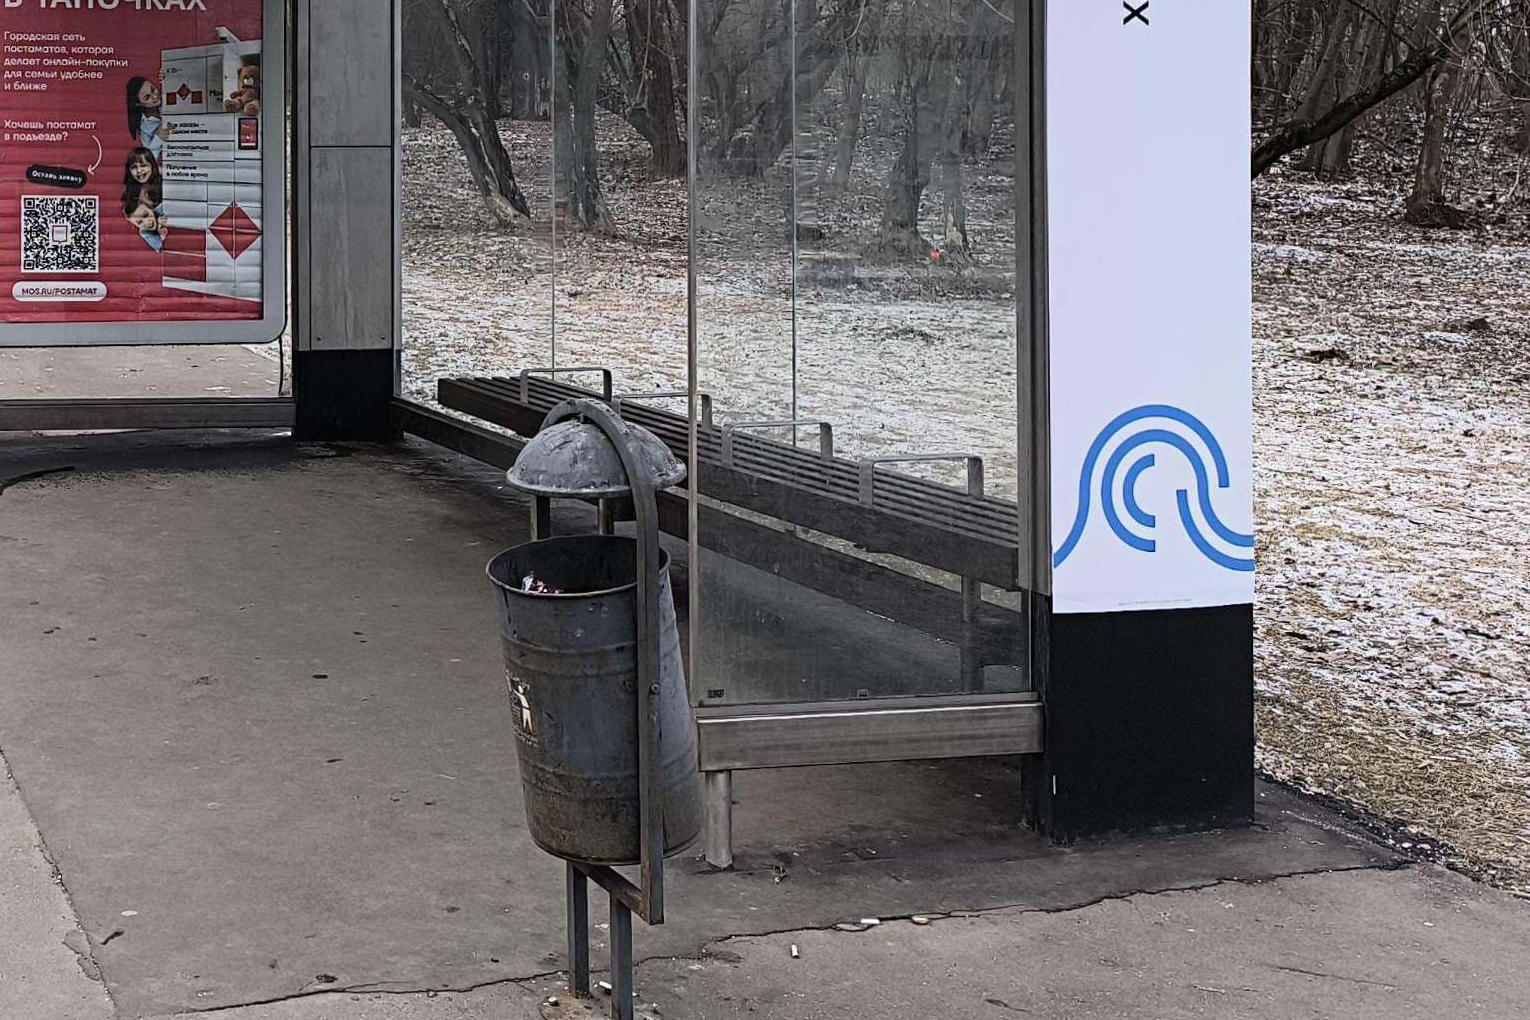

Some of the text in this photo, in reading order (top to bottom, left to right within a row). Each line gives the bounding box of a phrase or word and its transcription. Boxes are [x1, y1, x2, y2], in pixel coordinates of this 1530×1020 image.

[4, 31, 86, 42] Городская сеть
[4, 45, 114, 55] постаматов, которая
[4, 56, 129, 69] делает онлайн-покупки
[4, 70, 22, 78] для
[60, 70, 103, 80] удобнее
[13, 81, 47, 90] ближе
[4, 120, 96, 130] Хочешь постамат
[13, 131, 68, 141] подъезде?
[21, 287, 97, 295] MOS.RU/POSTAMAT
